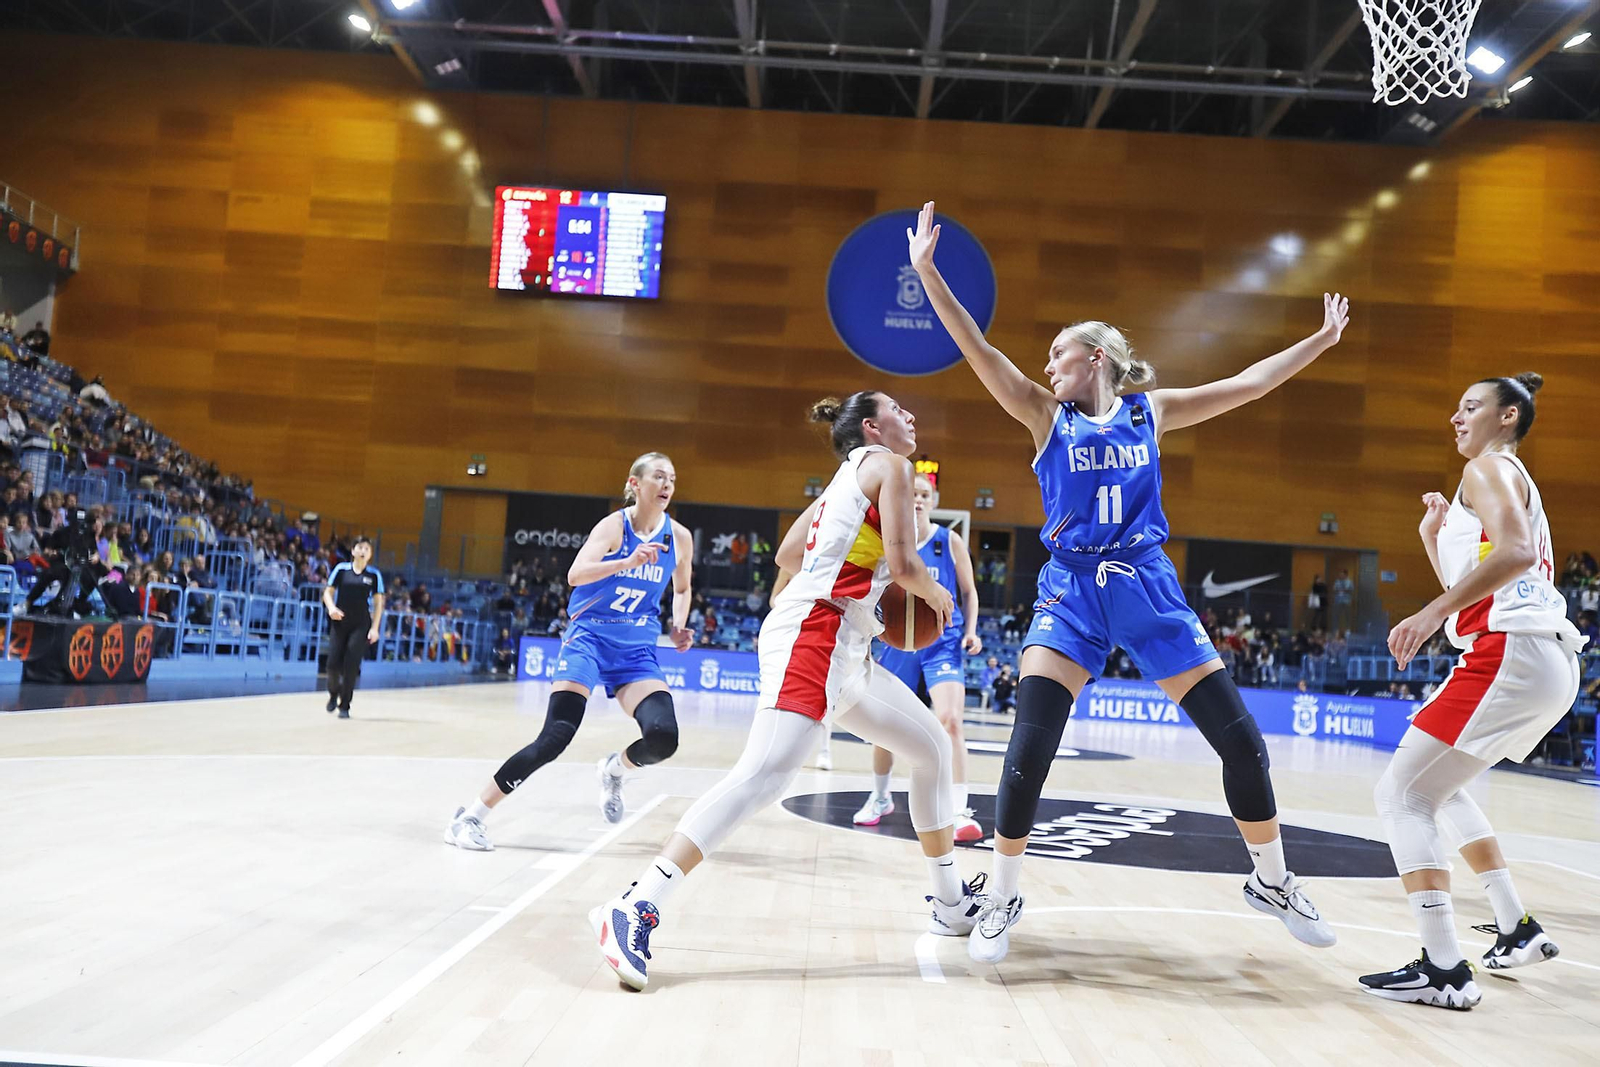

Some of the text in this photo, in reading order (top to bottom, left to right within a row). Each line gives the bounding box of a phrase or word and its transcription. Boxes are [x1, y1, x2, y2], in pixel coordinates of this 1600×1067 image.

[884, 317, 933, 330] HUELVA
[1067, 443, 1150, 473] ÍSLAND
[1096, 484, 1122, 524] 11
[615, 564, 664, 583] SLAND
[609, 586, 647, 613] 27
[720, 677, 760, 692] HUELV
[1091, 685, 1166, 700] Ayuntamiento
[1088, 698, 1180, 723] HUELVA
[1324, 714, 1376, 738] HUELVA
